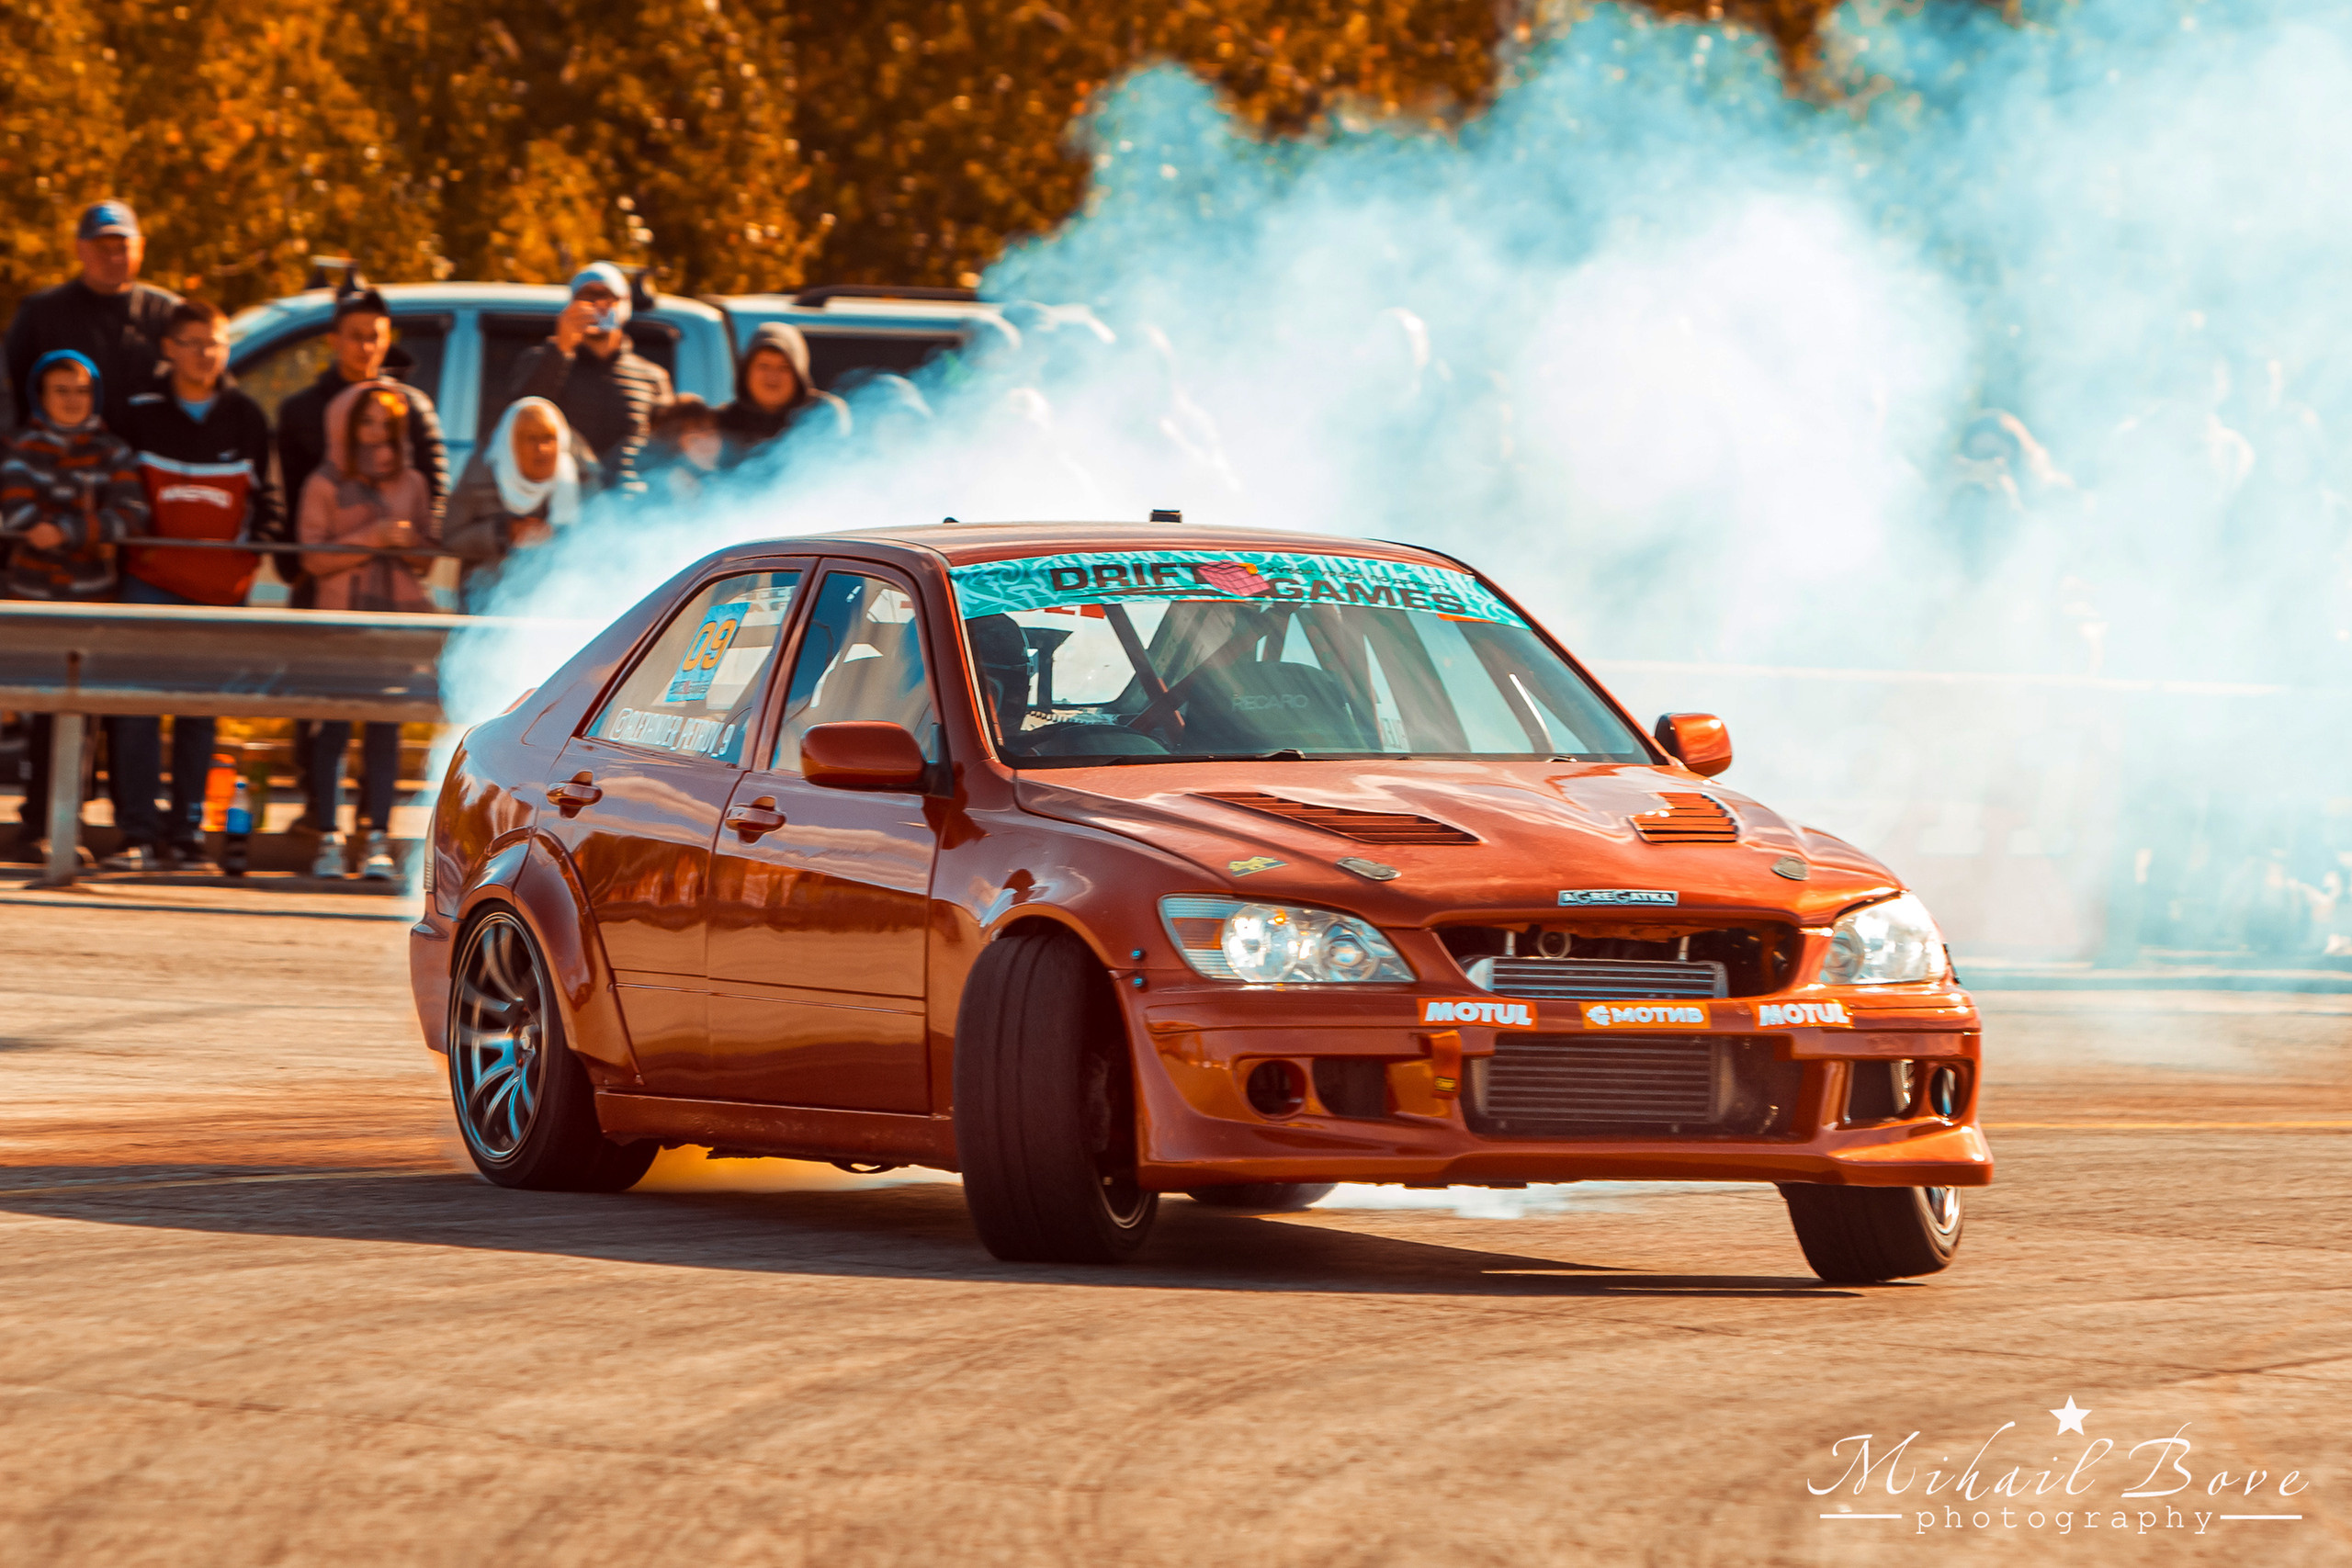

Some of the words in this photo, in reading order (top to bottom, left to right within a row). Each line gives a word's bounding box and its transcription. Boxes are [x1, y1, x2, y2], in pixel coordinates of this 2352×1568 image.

[1050, 563, 1211, 591] DRIFT
[1264, 577, 1466, 614] GAMES
[682, 619, 737, 671] 09
[1232, 694, 1308, 711] RECARO
[1425, 1002, 1532, 1026] MOTUL
[1611, 1006, 1704, 1024] МОТИВ
[1758, 1003, 1849, 1027] MOTUL
